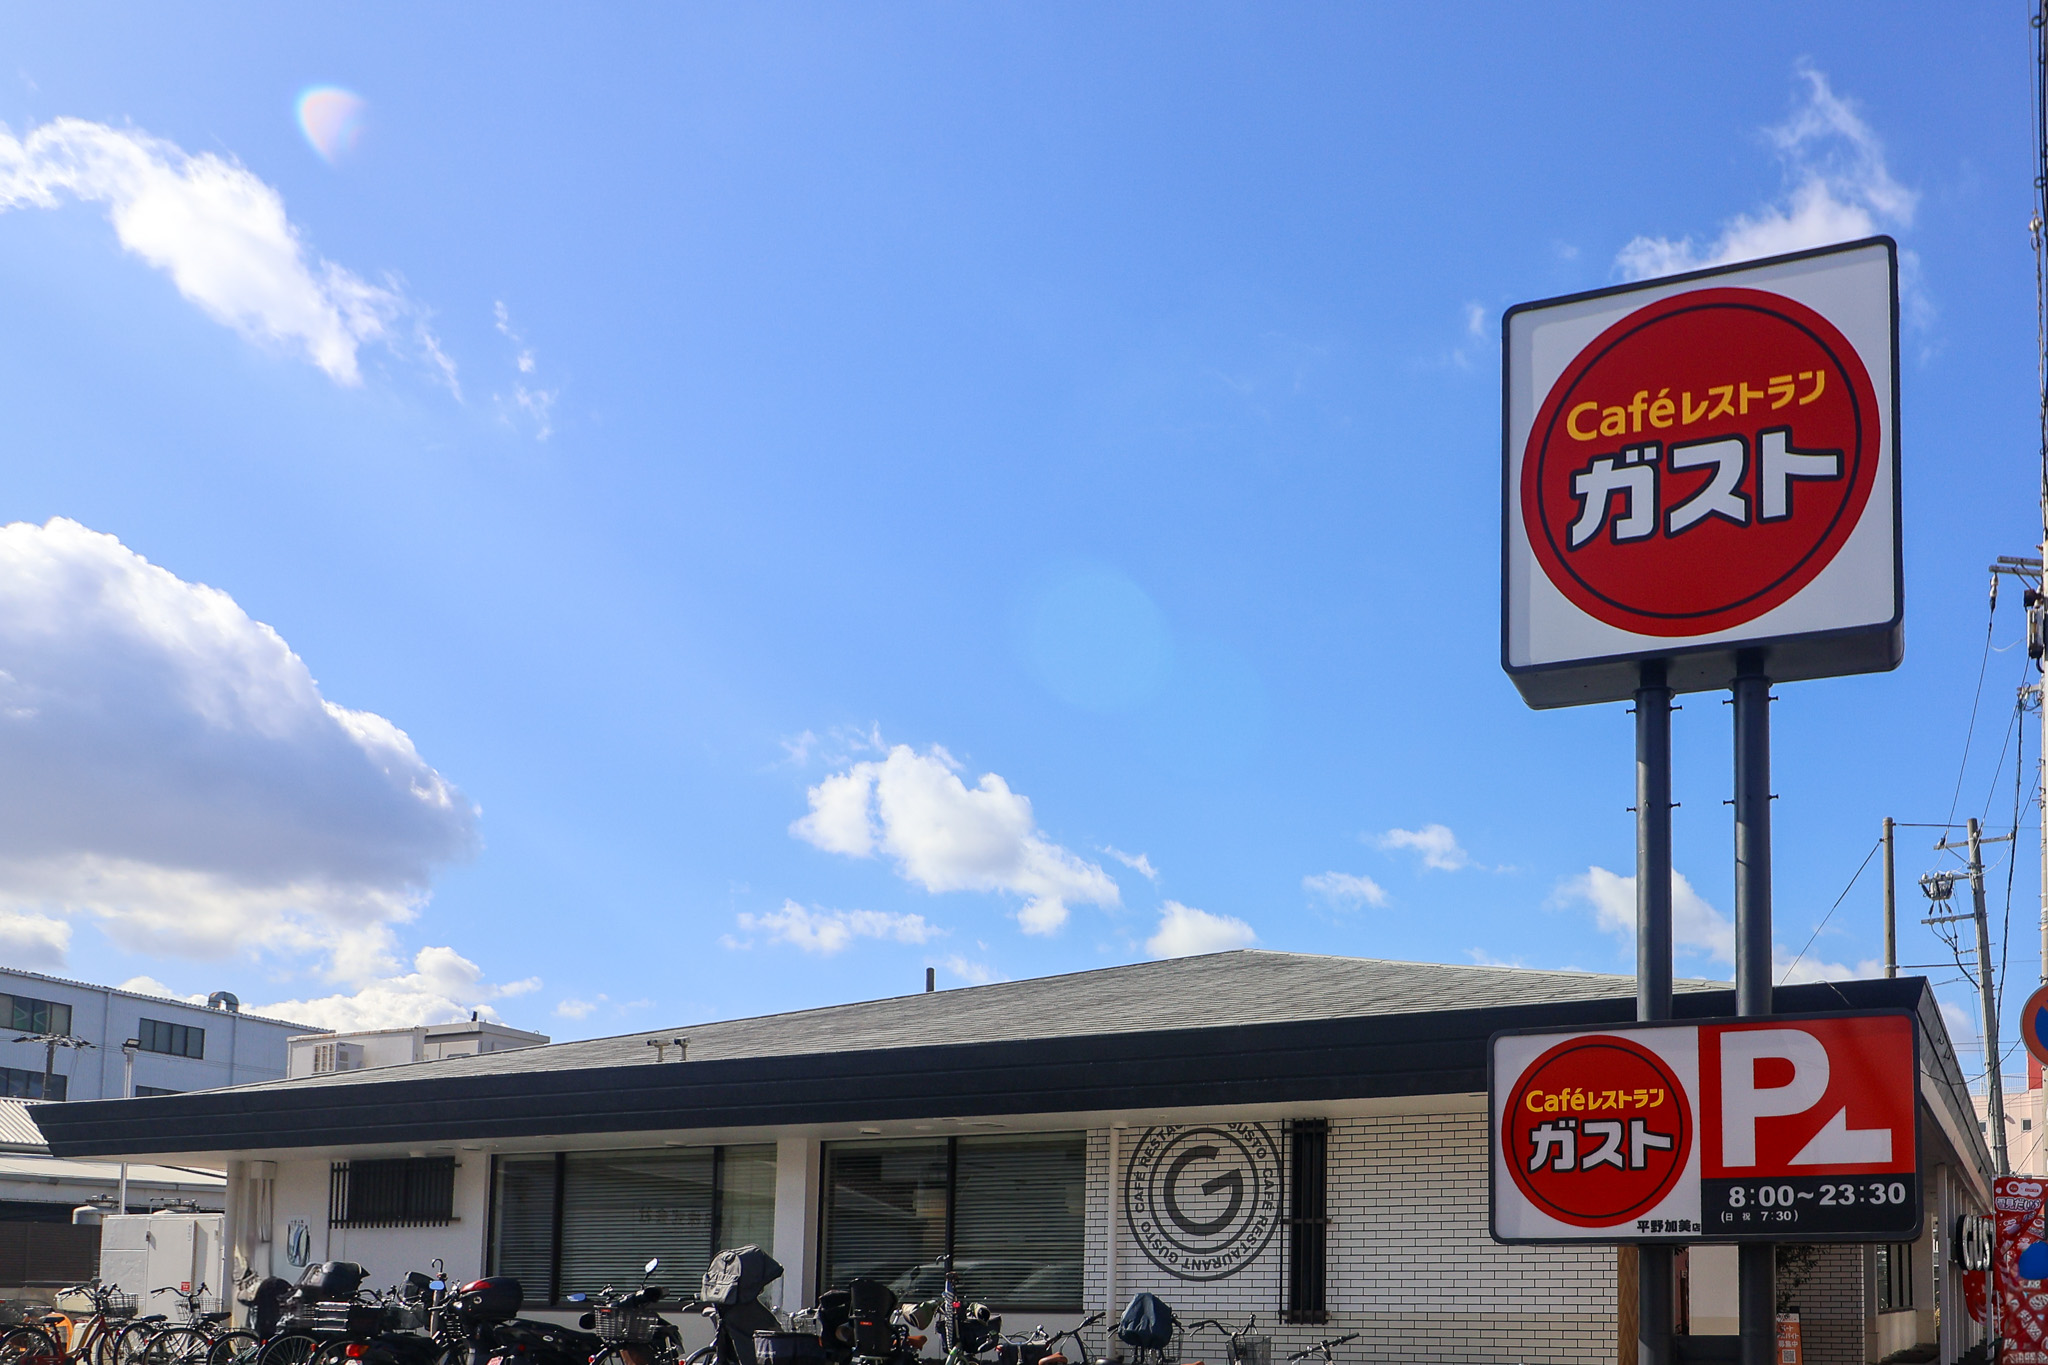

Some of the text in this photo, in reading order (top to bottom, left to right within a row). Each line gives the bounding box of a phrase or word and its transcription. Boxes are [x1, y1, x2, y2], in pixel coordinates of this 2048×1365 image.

[1566, 369, 1825, 441] Caféレストラン
[1568, 427, 1843, 551] ガスト
[1526, 1088, 1665, 1113] Caféレストラン
[1719, 1028, 1830, 1168] P
[1529, 1118, 1673, 1174] ガスト
[1141, 1221, 1179, 1264] GUSTO
[1181, 1215, 1269, 1271] RESTAURANT
[1637, 1219, 1701, 1233] 平野加美店
[1963, 1215, 1993, 1271] GUS
